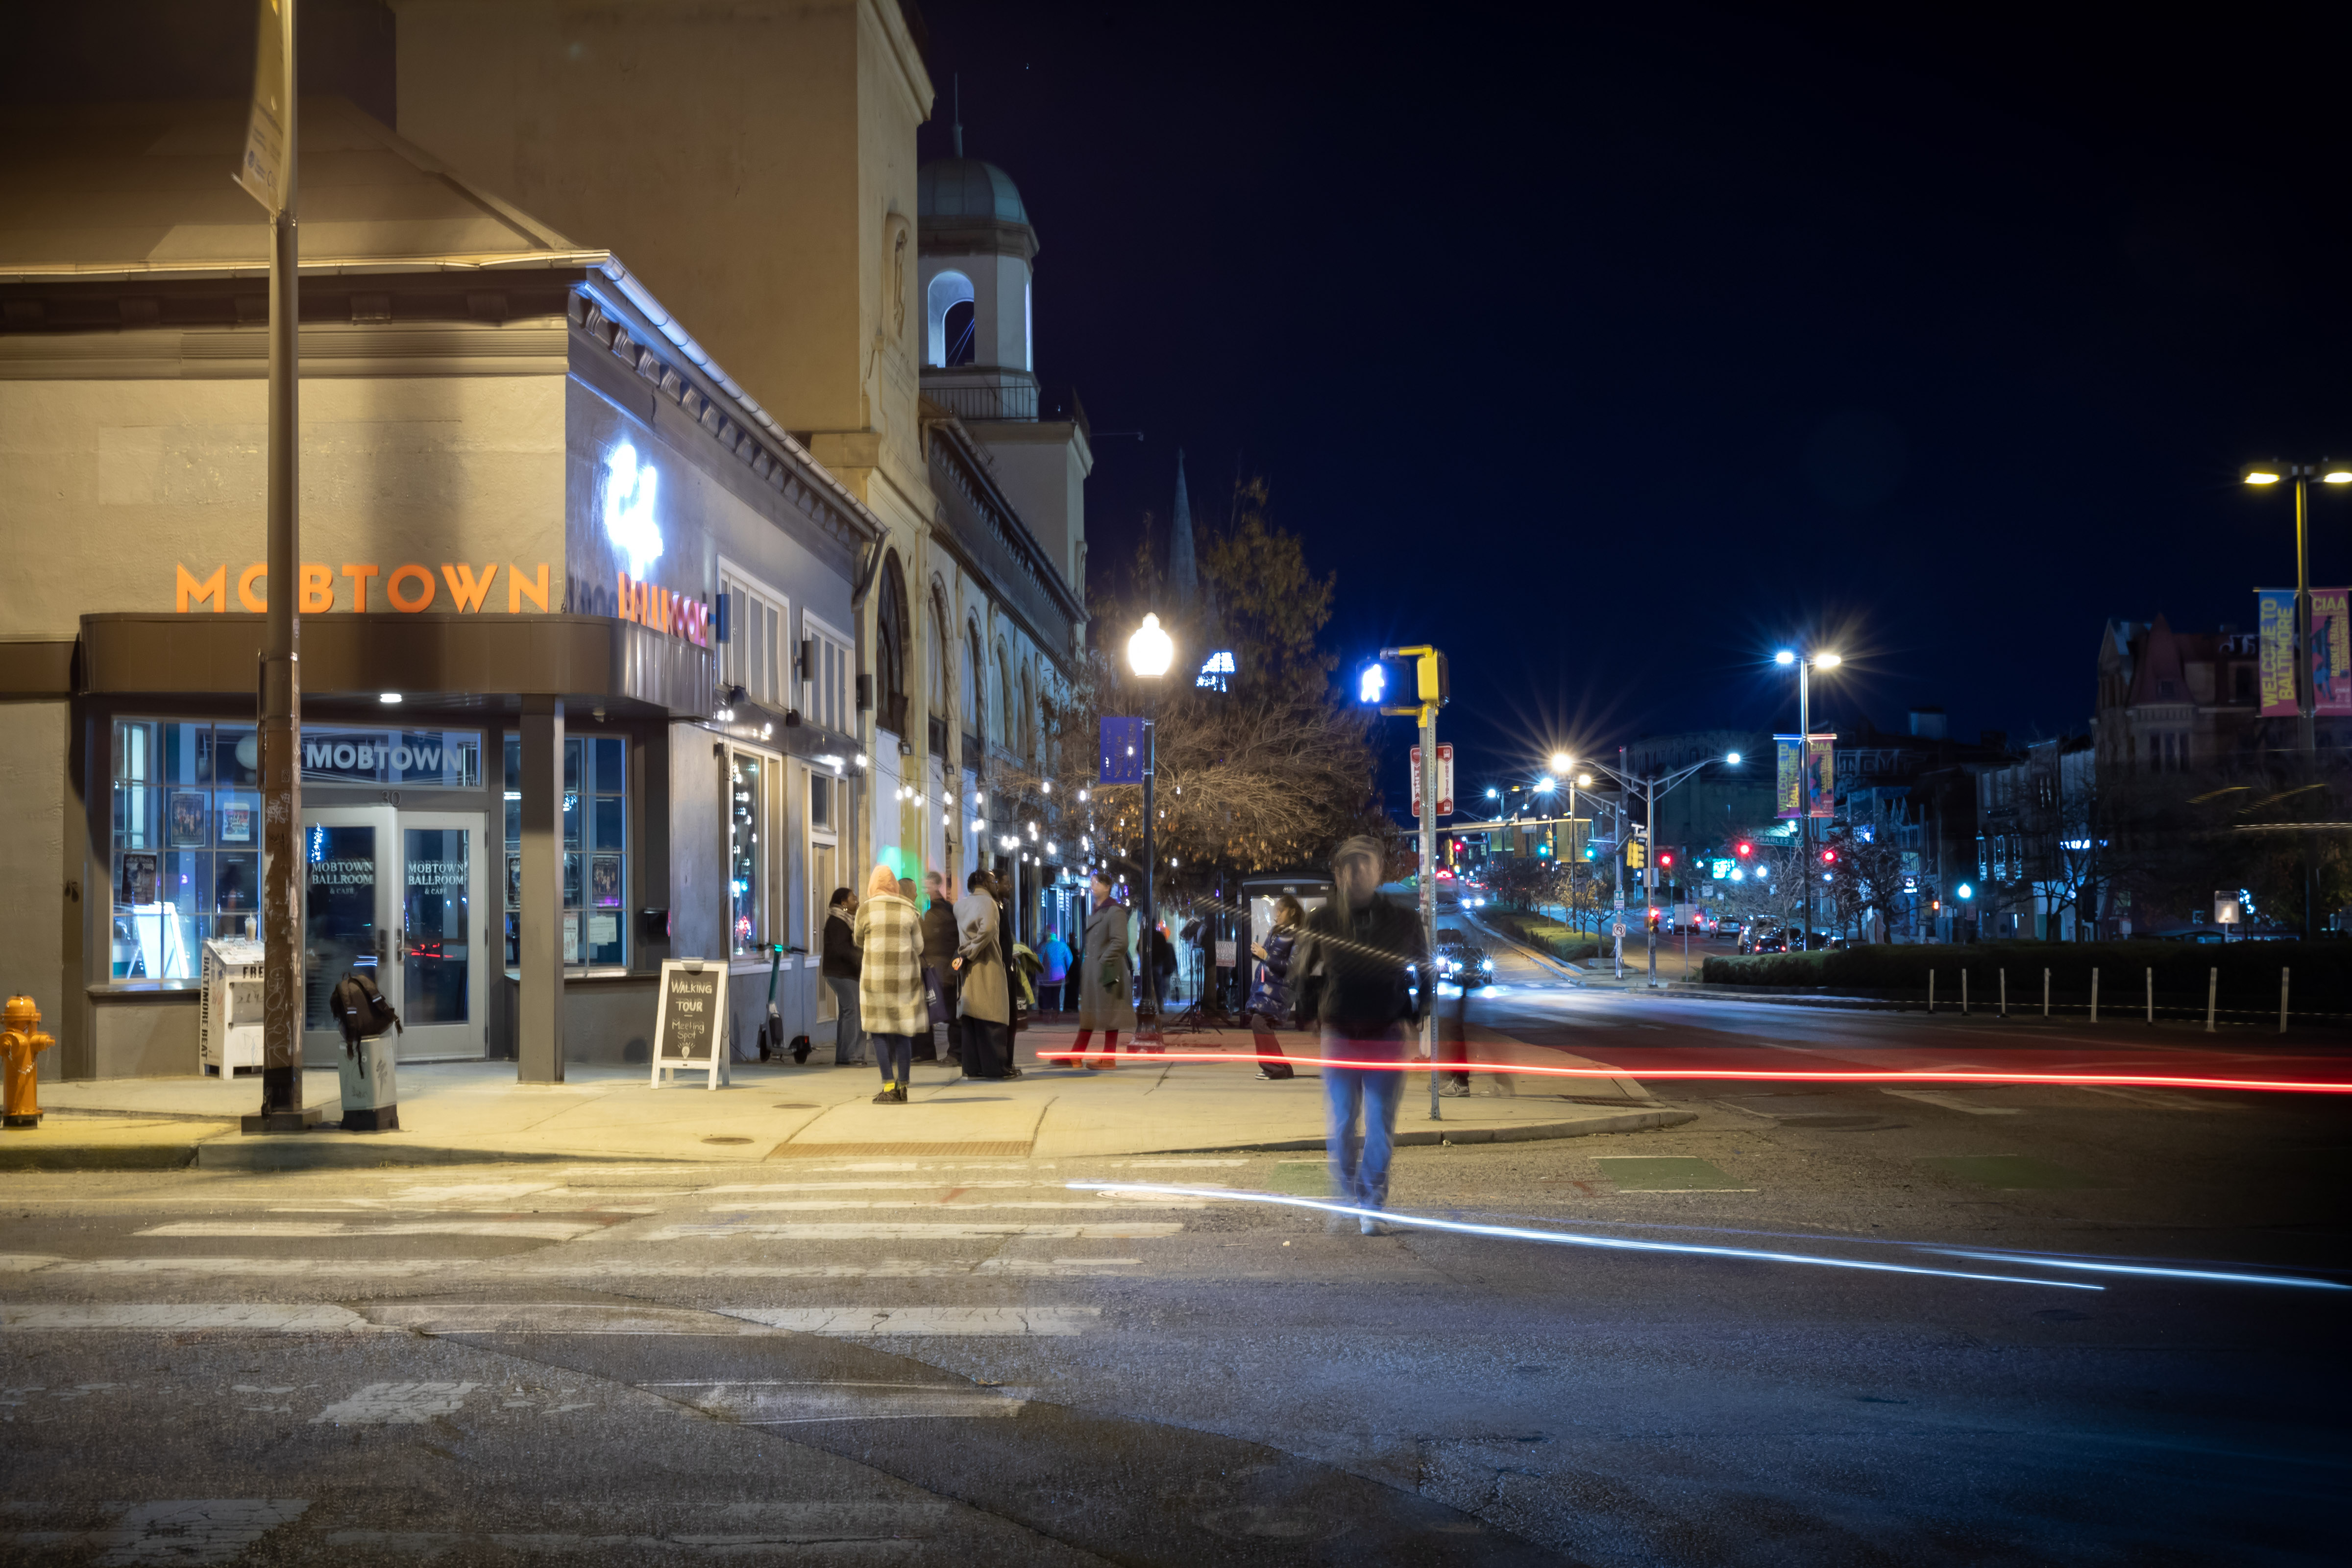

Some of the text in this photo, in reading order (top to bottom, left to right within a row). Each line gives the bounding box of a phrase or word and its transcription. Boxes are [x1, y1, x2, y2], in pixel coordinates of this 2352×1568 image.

[176, 563, 550, 613] MOBTOWN
[618, 572, 708, 647] BALLROOM
[2260, 599, 2277, 622] TO
[2312, 596, 2348, 612] CIAA
[2277, 607, 2295, 700] BALTIMORE
[1810, 742, 1832, 751] CIAA
[306, 743, 462, 771] MOBTOWN
[1778, 744, 1789, 812] WELCOME TO
[1789, 749, 1799, 808] BALTIMORE
[381, 790, 401, 807] 30
[1755, 836, 1789, 844] CHARLES
[312, 861, 373, 872] MOBTOWN
[408, 863, 464, 874] MOBTOWN
[312, 874, 373, 884] BALLROOM
[408, 876, 464, 885] BALLROOM
[243, 966, 265, 979] FRE
[201, 956, 210, 1027] BALTIMORE
[671, 980, 712, 994] WALKING
[675, 1001, 703, 1012] TOUR
[672, 1021, 704, 1034] Meeting
[677, 1030, 696, 1042] Spot
